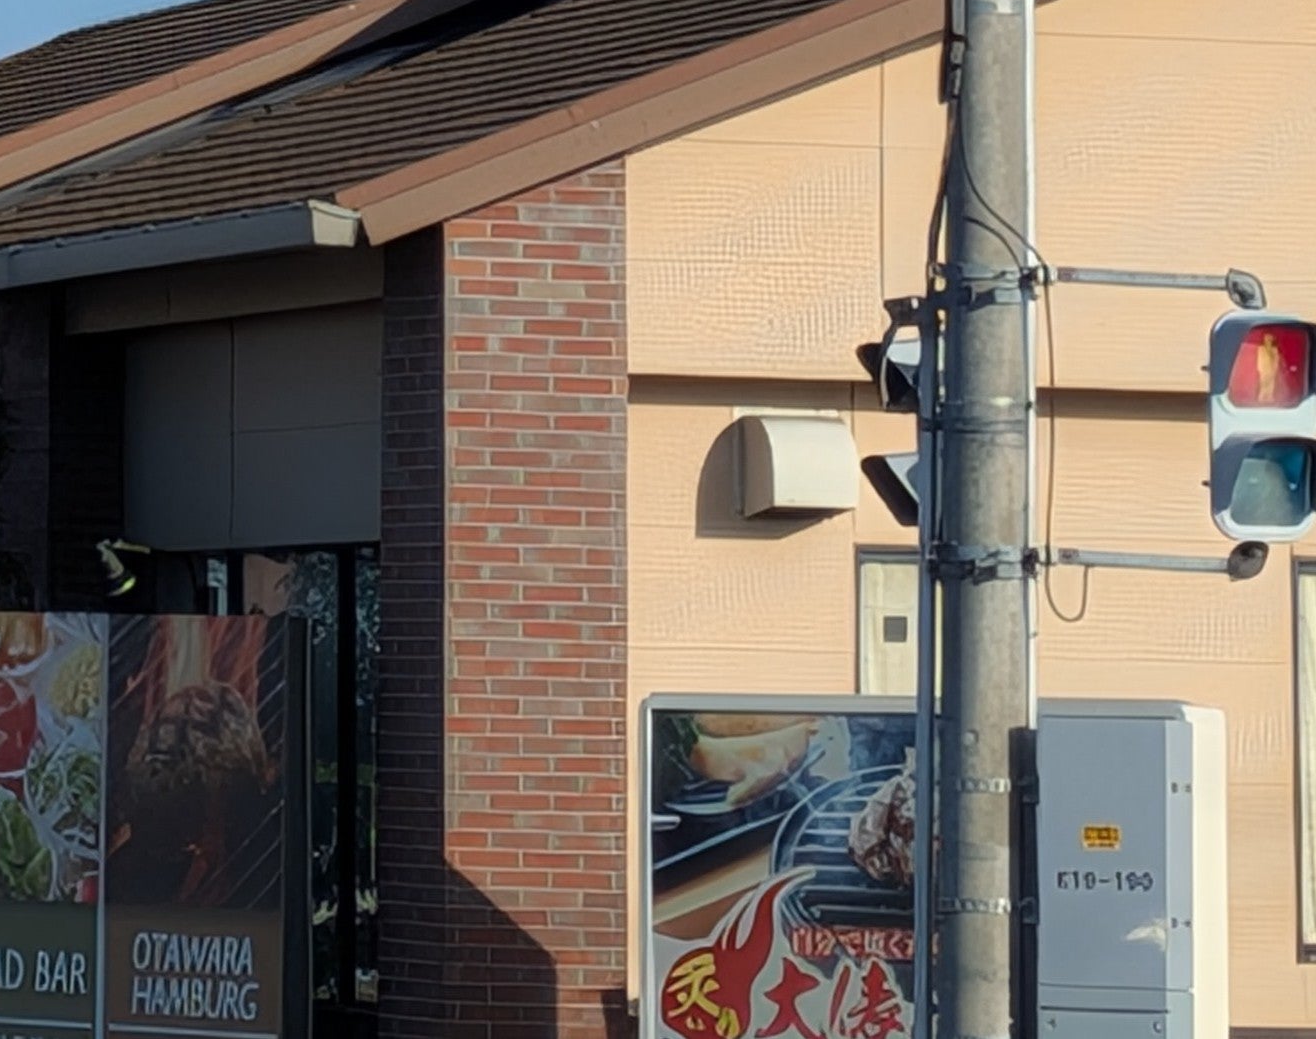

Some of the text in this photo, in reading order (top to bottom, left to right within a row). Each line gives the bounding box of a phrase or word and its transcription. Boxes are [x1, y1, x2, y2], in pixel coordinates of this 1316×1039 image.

[35, 950, 86, 994] BAR
[132, 932, 253, 975] OTAWARA
[131, 976, 257, 1020] HAMBURG
